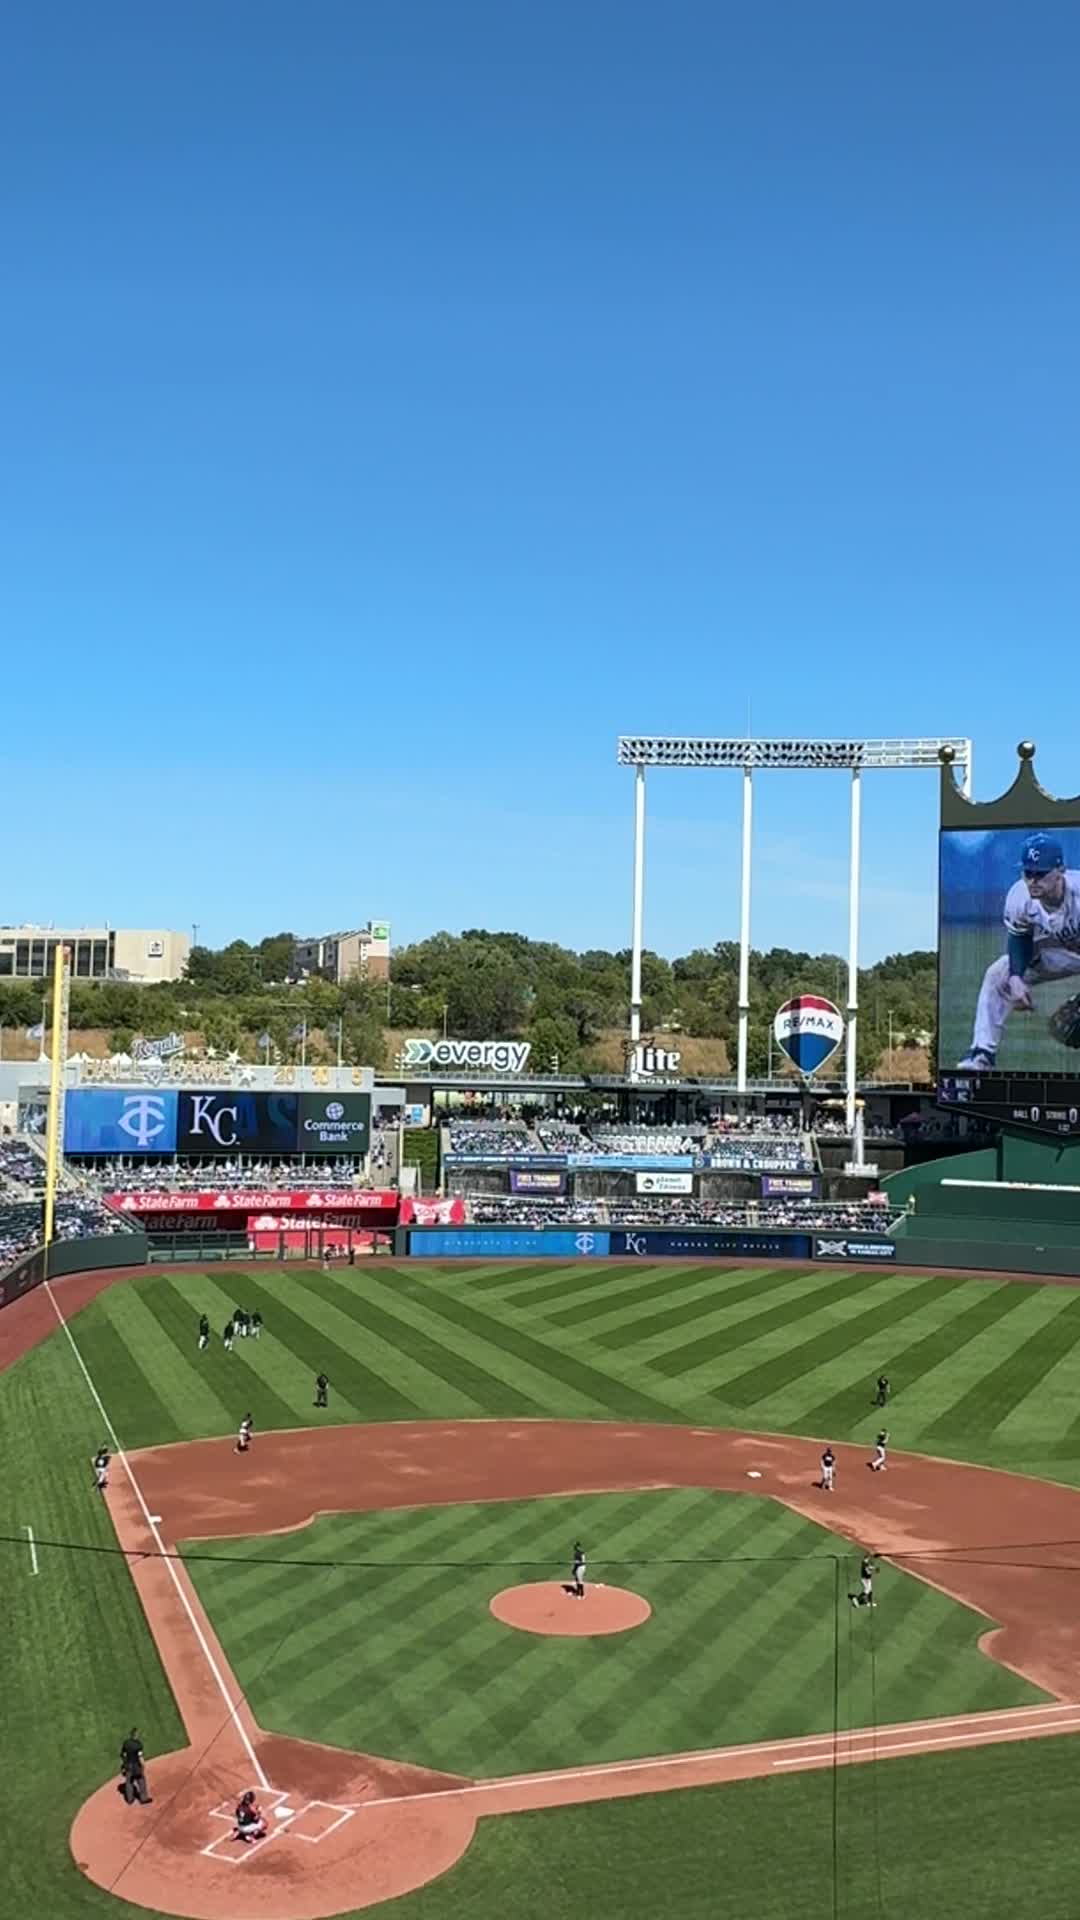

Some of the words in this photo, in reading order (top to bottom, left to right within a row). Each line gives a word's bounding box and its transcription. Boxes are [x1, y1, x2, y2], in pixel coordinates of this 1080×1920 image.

[783, 1016, 834, 1030] RE/MAX
[436, 1044, 529, 1070] evergy
[631, 1046, 681, 1076] Lite
[190, 1096, 237, 1146] KC
[1031, 1106, 1040, 1122] 0
[1069, 1107, 1078, 1124] 0
[304, 1119, 364, 1131] Commerce
[319, 1131, 348, 1142] Bank
[625, 1233, 647, 1256] KC
